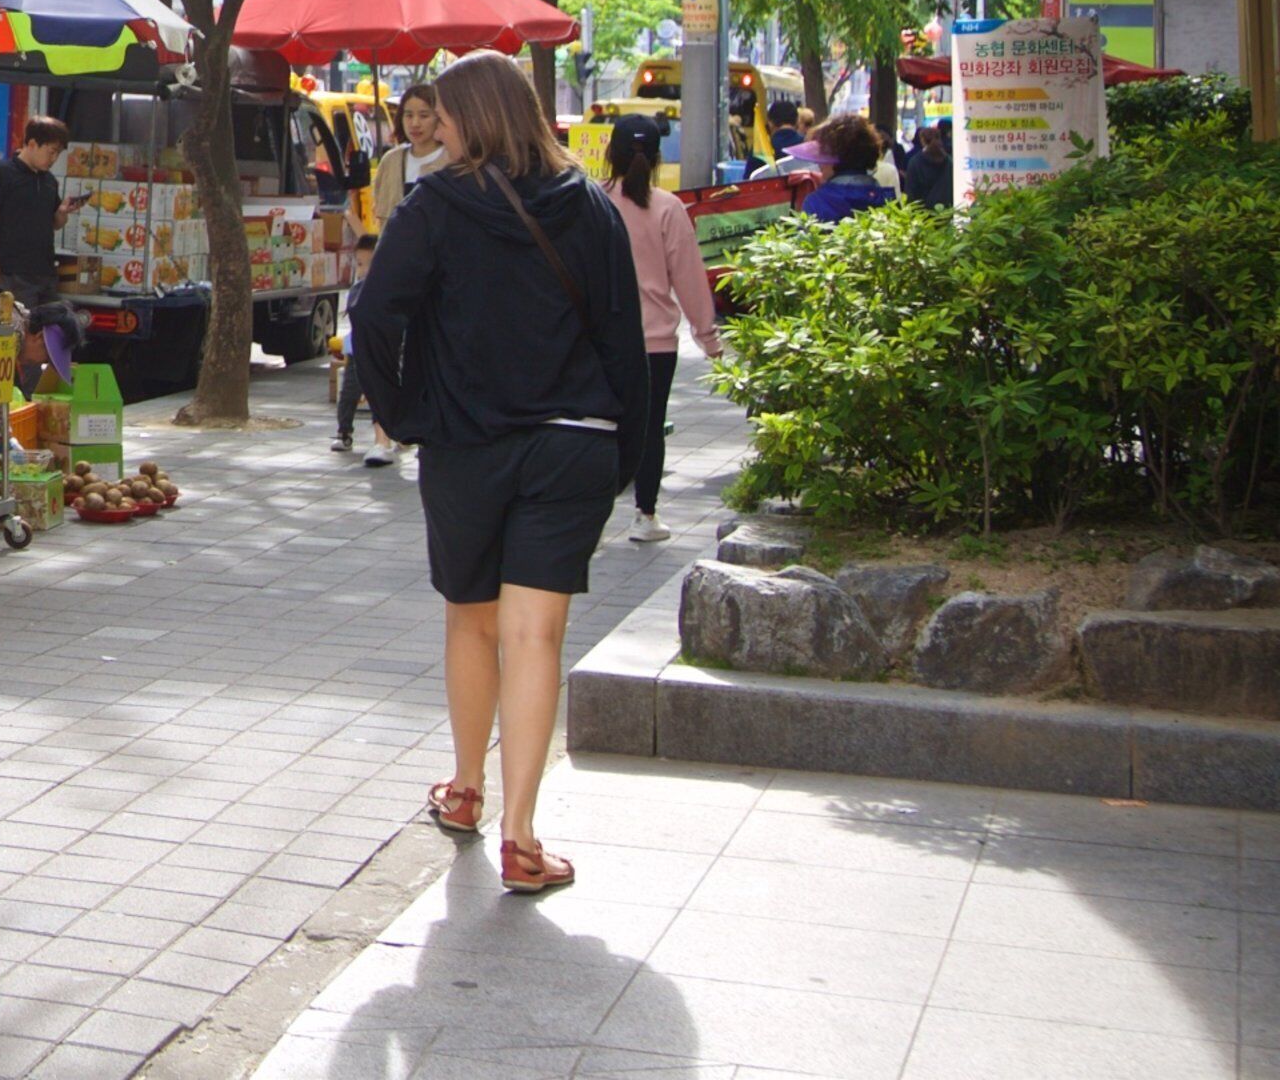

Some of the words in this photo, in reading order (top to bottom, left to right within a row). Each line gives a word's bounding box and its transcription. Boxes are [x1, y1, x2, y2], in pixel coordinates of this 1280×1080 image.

[962, 24, 979, 32] NH
[975, 40, 1005, 58] 농협
[1012, 39, 1076, 57] 문화센터
[960, 59, 1022, 78] 민화강좌
[1028, 57, 1091, 76] 회원모집
[1007, 132, 1026, 143] 9시
